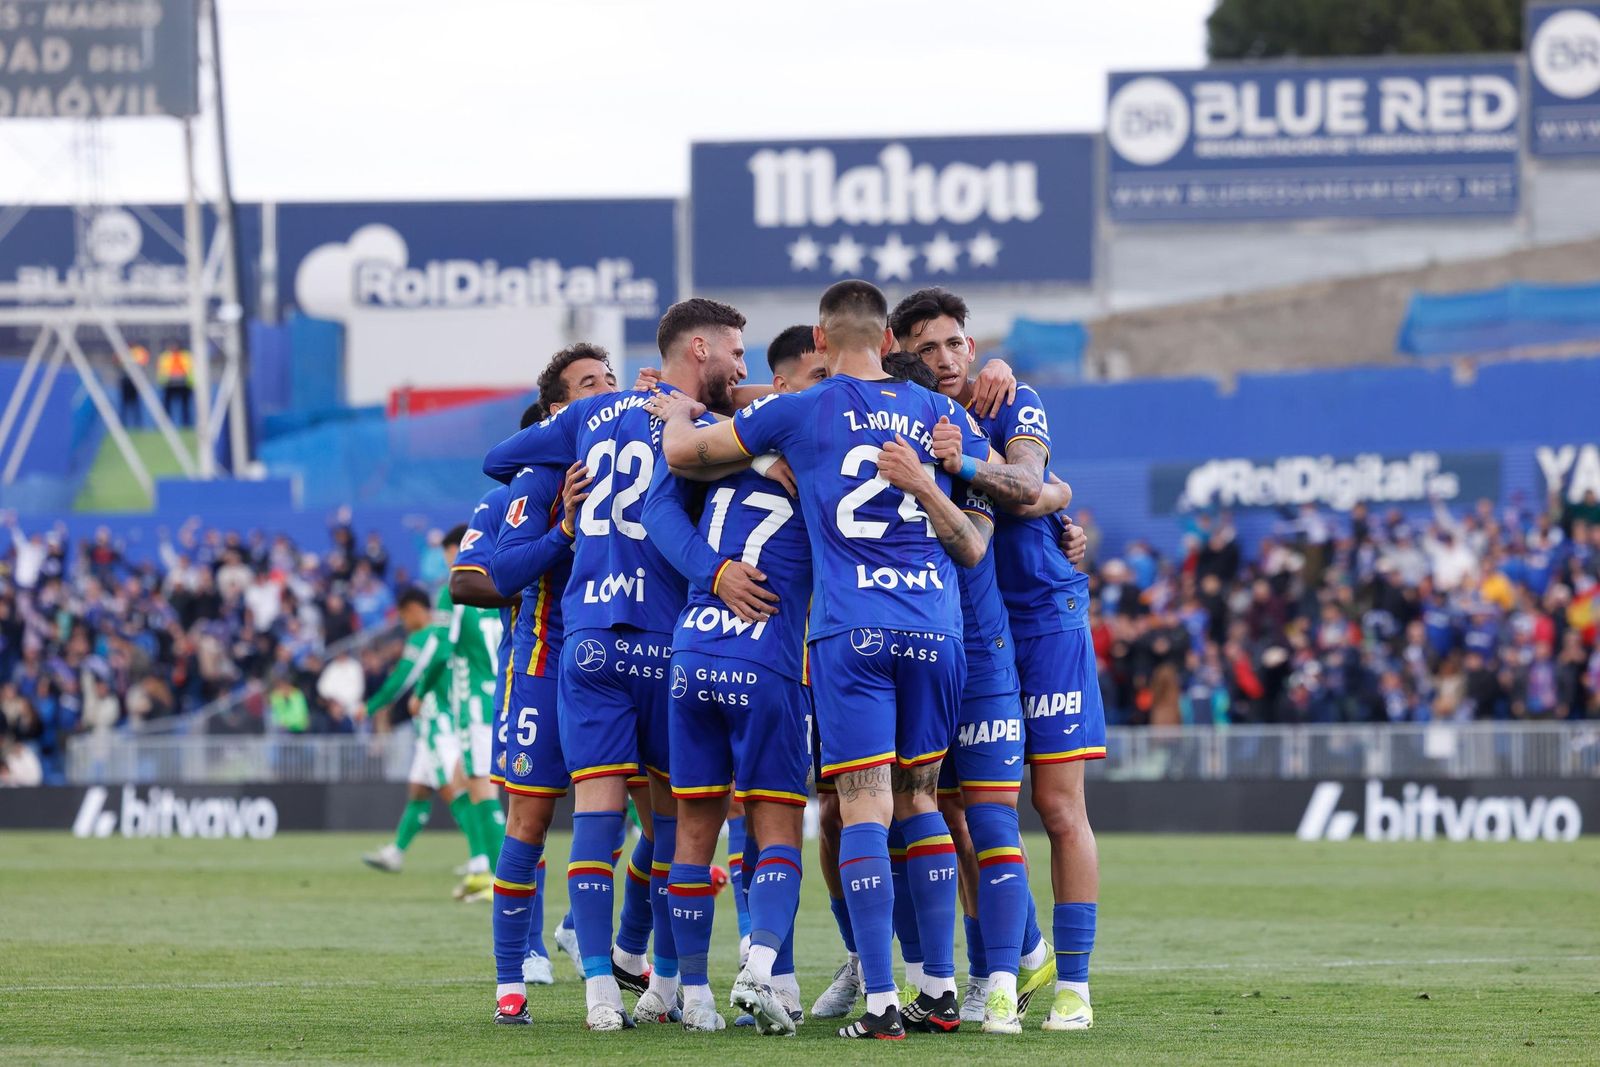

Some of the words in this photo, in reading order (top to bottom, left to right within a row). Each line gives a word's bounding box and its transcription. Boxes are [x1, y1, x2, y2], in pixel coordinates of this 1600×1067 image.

[0, 36, 72, 74] AD
[1193, 79, 1368, 138] BLUE
[1379, 75, 1518, 134] RED
[748, 144, 1042, 228] Mahou
[580, 439, 655, 540] 22
[707, 487, 794, 568] 17
[696, 668, 757, 684] GRAND
[1024, 691, 1081, 719] MAPEI
[516, 707, 539, 746] 5
[959, 718, 1020, 747] MAPEI
[120, 783, 278, 839] bitvavo
[1363, 780, 1582, 841] bitvavo
[578, 882, 610, 892] GTF
[757, 872, 787, 884] GTF
[851, 875, 881, 892] GTF
[929, 867, 955, 882] GTF
[673, 907, 703, 921] GTF
